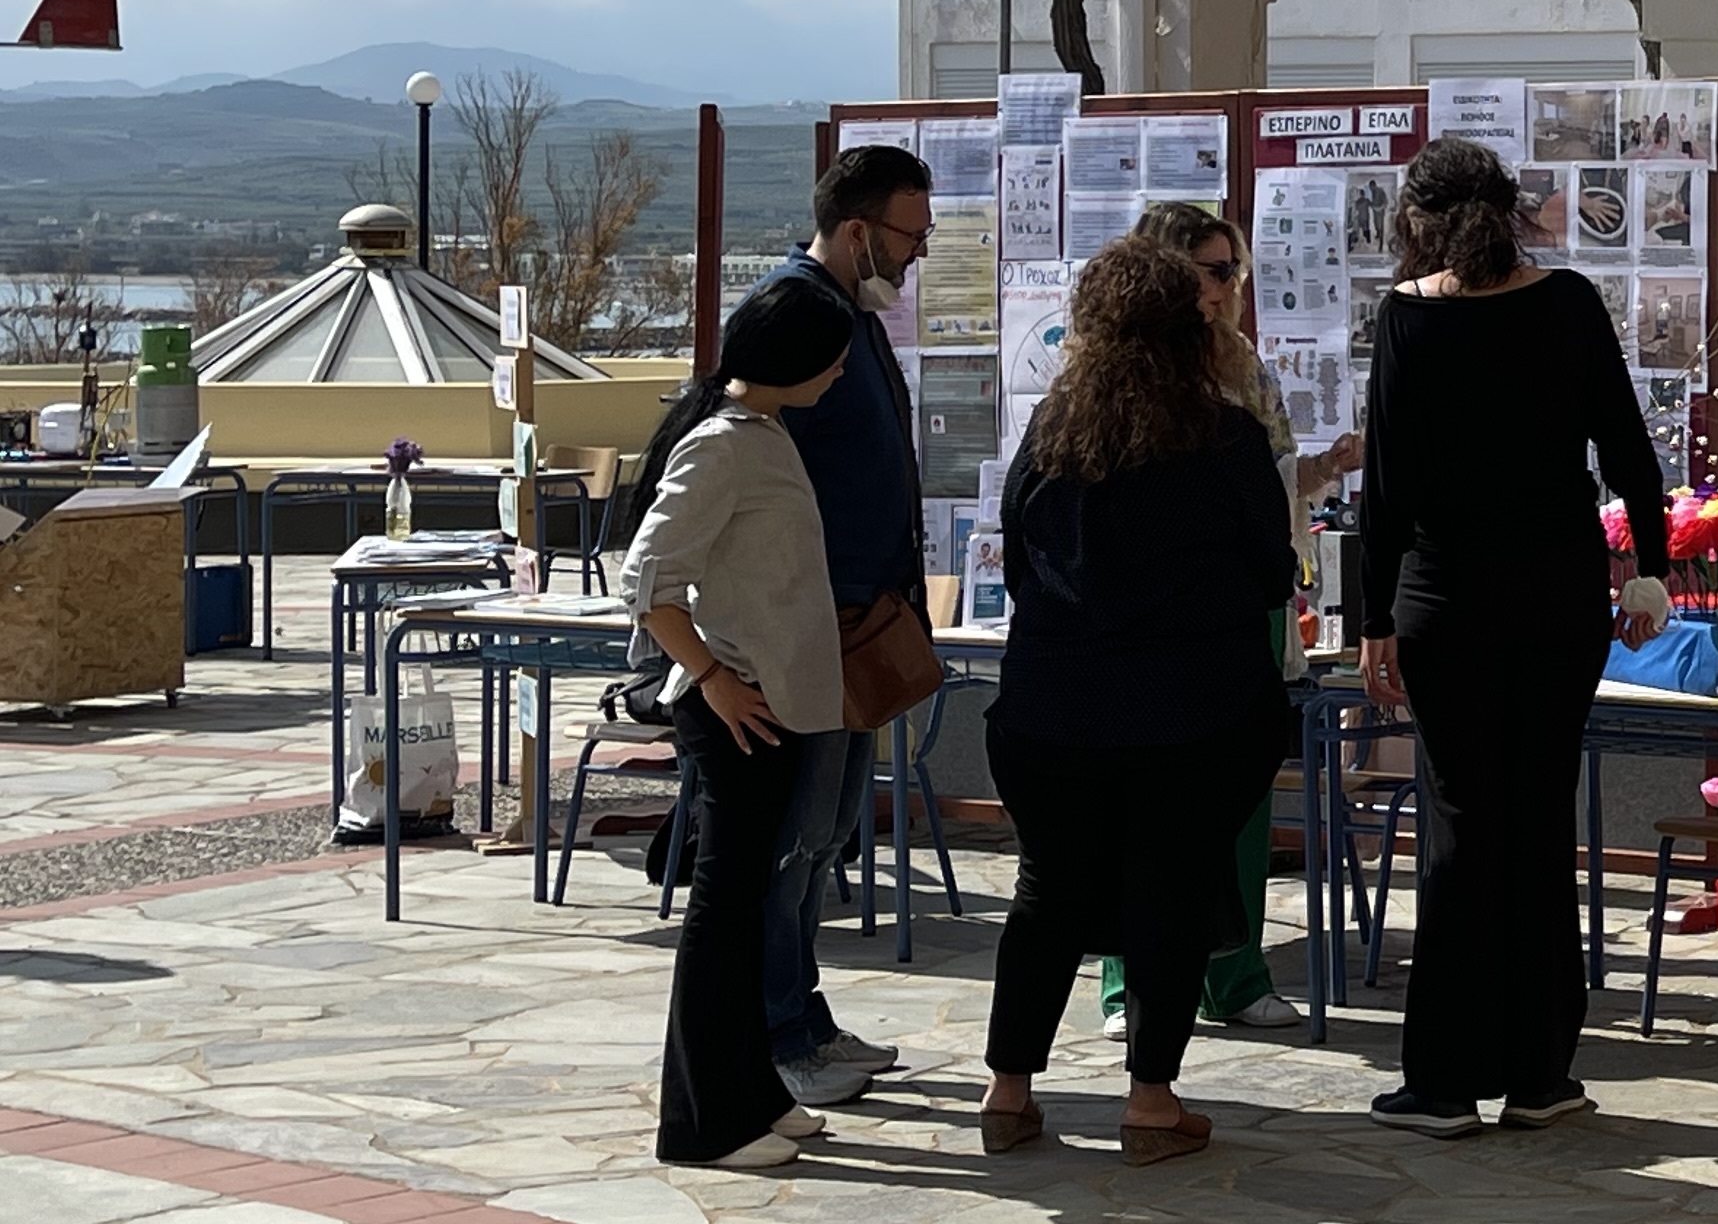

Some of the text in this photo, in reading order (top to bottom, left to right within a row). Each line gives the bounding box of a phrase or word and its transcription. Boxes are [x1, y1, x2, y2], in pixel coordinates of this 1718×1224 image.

[1268, 112, 1410, 133] ΕΣΠΕΡΙΝΟ ΕΠΑΛ
[1305, 141, 1382, 158] ΠΛΑΤΑΝΙΑ
